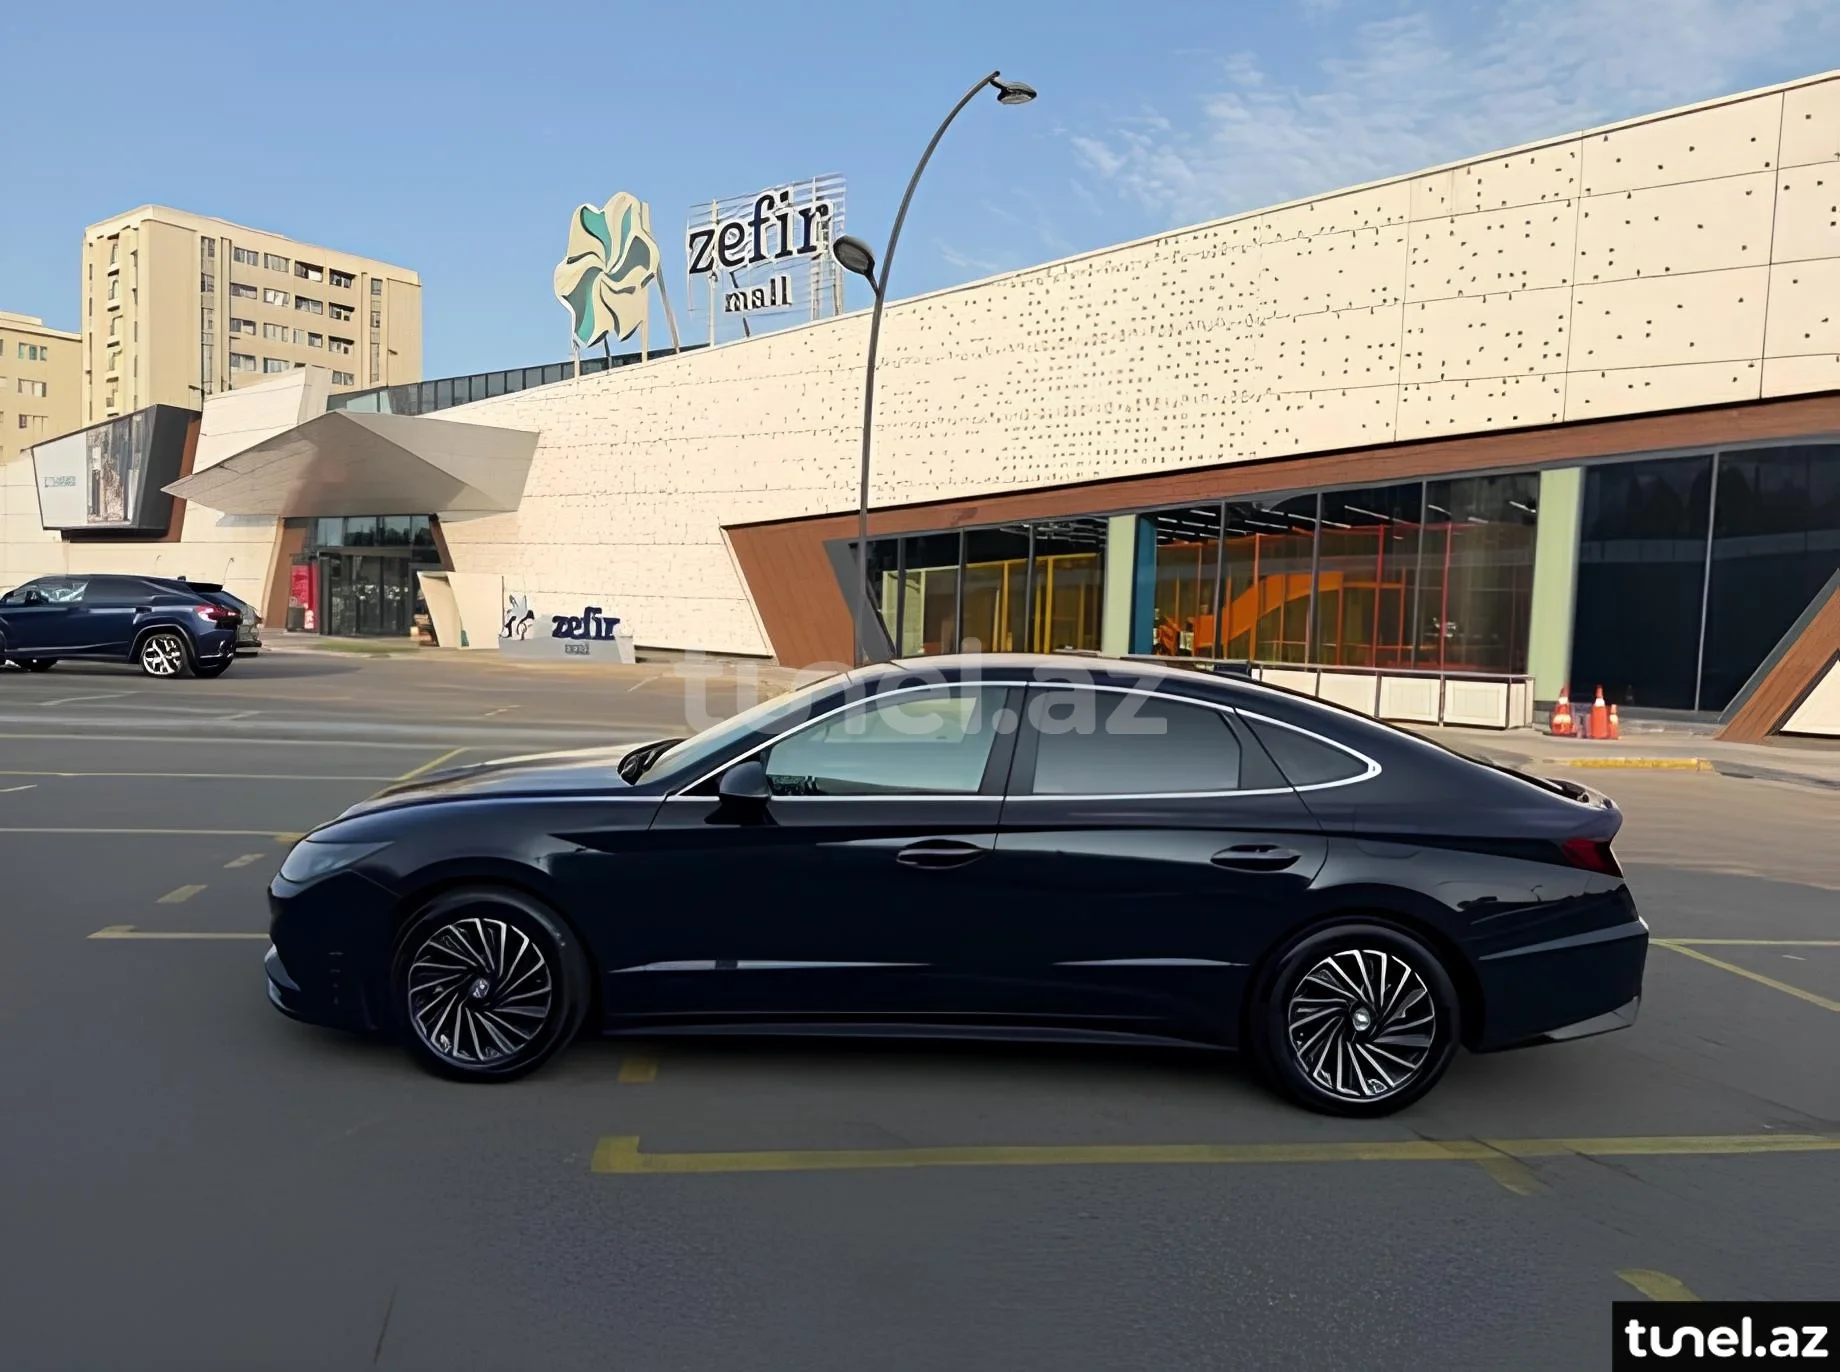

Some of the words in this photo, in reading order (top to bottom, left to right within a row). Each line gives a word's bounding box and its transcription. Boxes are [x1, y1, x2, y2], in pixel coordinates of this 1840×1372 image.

[688, 190, 830, 274] zefir
[725, 275, 792, 312] mall
[551, 606, 621, 640] zefir
